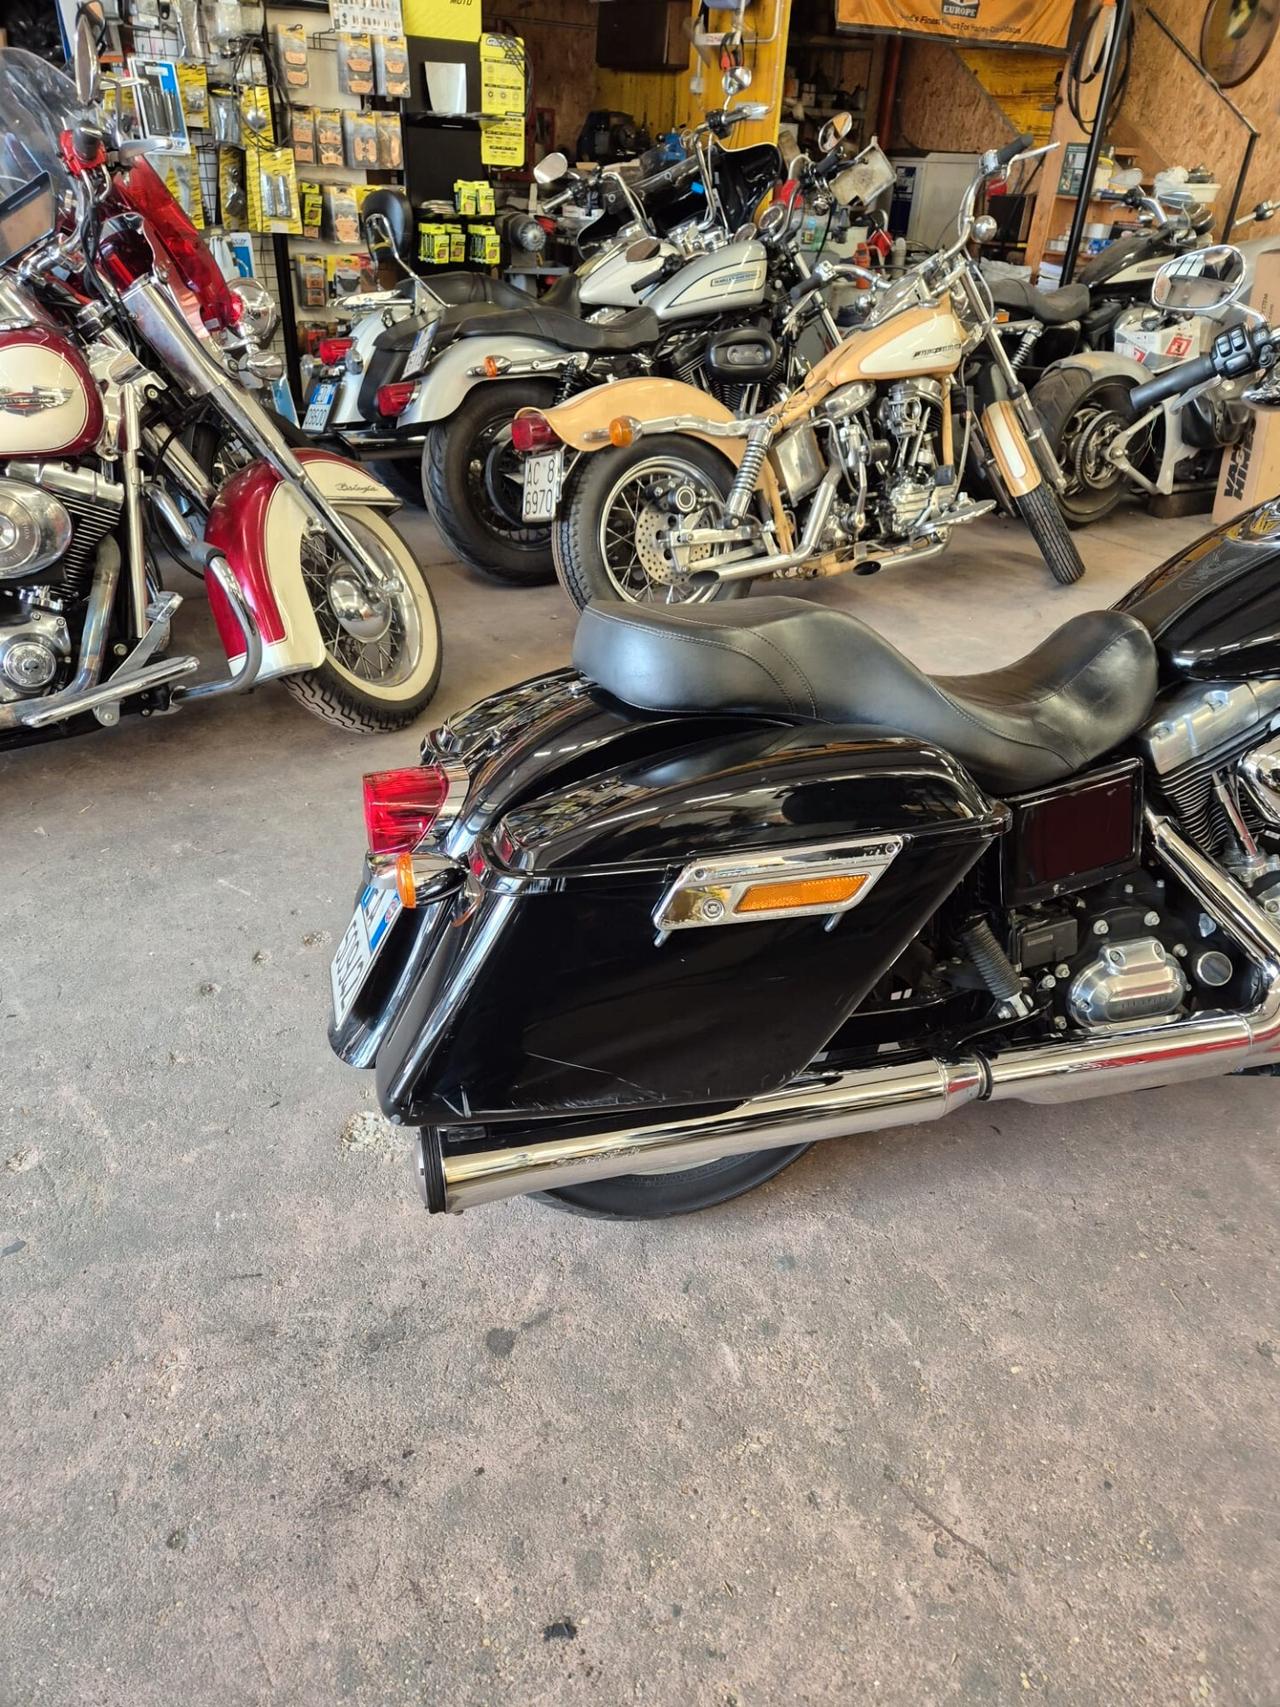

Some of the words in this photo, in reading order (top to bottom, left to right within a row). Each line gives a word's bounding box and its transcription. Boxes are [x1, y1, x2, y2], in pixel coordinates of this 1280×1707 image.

[943, 5, 977, 17] EUROPE
[527, 461, 540, 486] AC
[547, 459, 555, 484] 8
[525, 489, 553, 515] 6970
